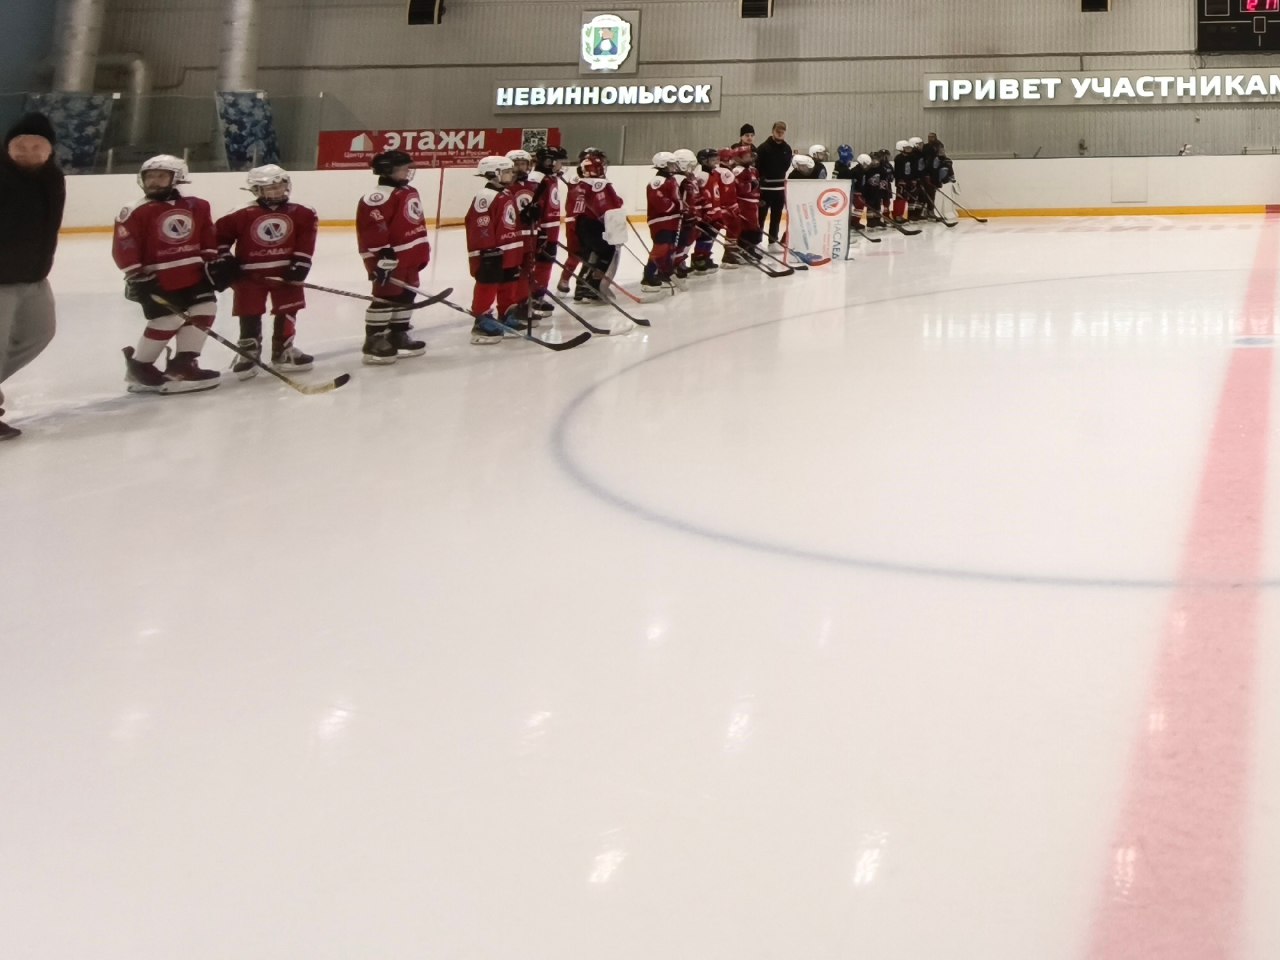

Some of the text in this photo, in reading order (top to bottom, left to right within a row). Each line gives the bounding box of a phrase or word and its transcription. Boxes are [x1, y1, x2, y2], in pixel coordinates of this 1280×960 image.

[496, 84, 712, 106] НЕВИННОМЫССК
[929, 77, 1062, 102] ПРИВЕТ
[383, 131, 485, 151] этажи
